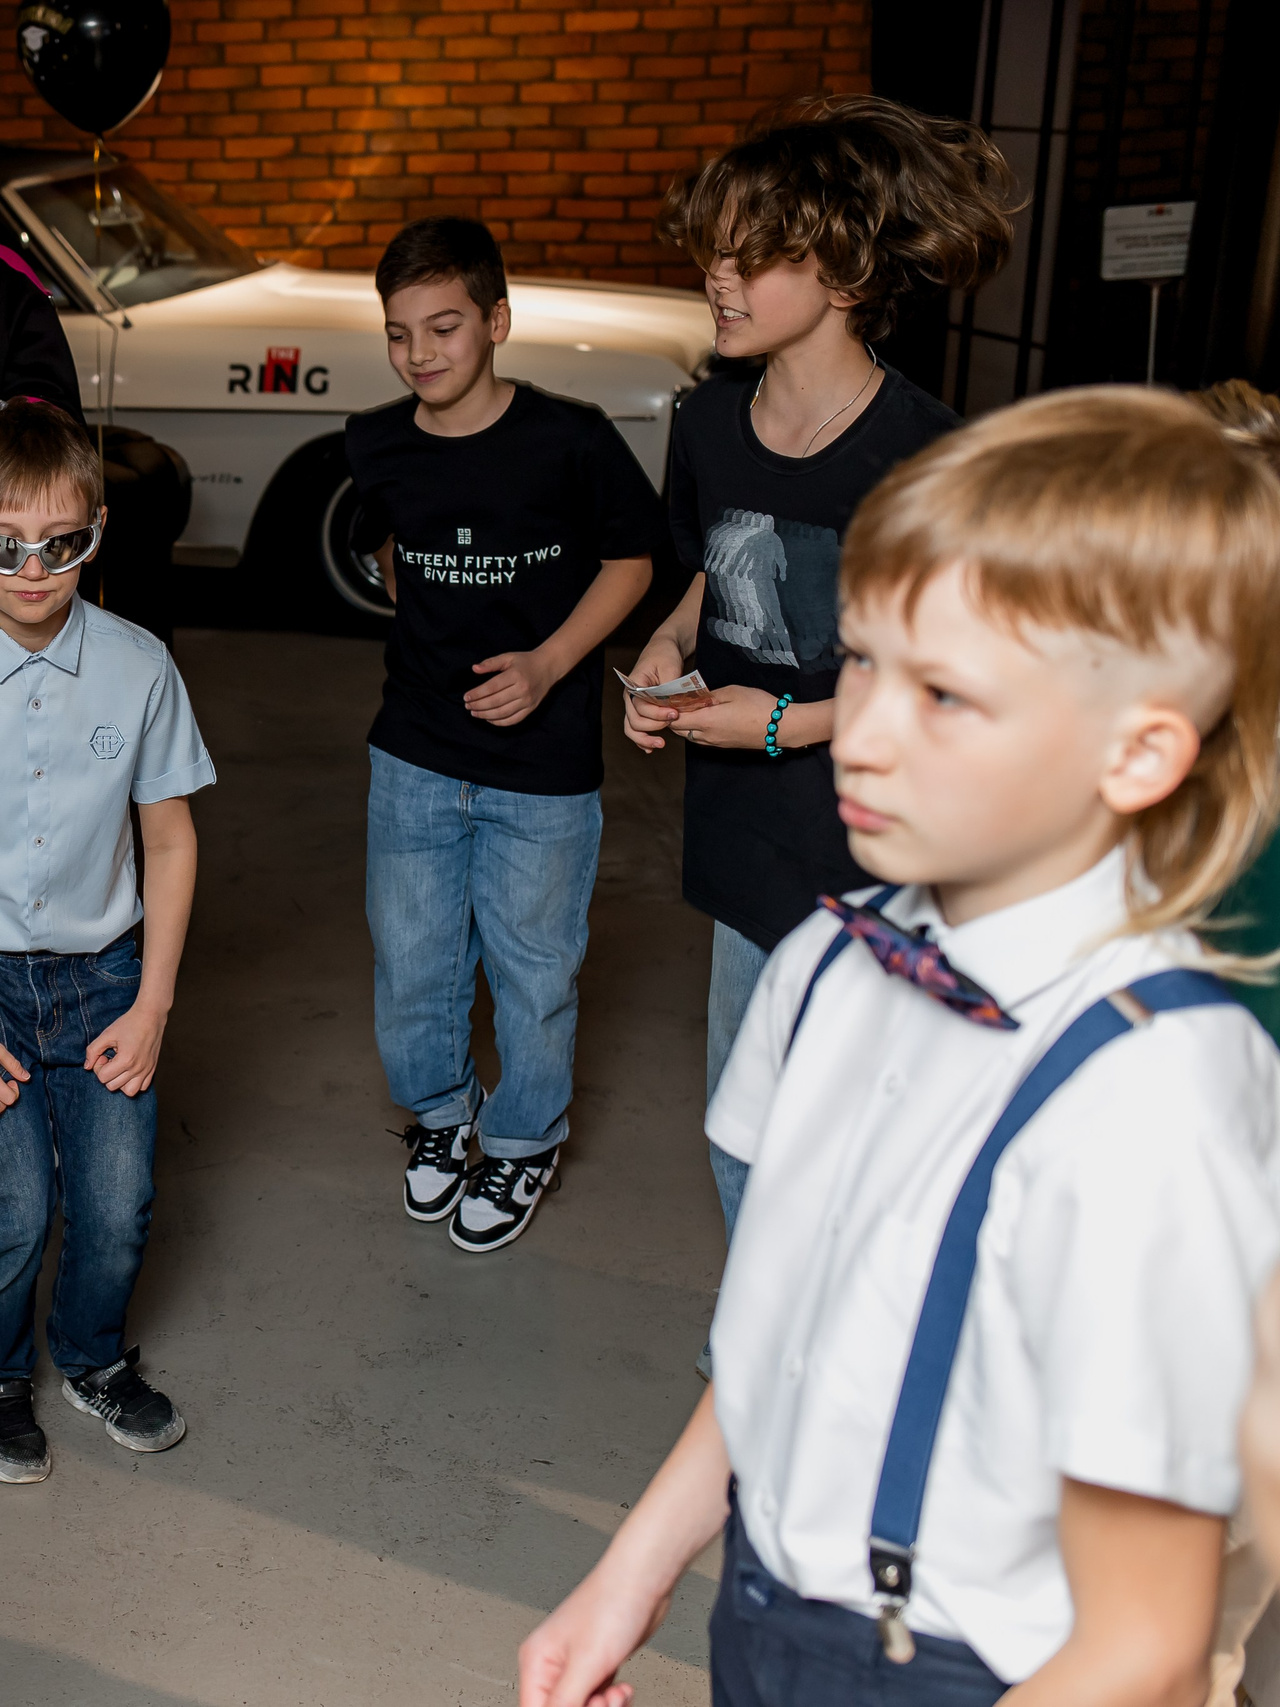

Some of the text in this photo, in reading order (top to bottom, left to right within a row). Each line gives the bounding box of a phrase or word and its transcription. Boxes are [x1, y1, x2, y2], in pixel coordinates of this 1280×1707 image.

[228, 364, 330, 395] RING
[464, 555, 517, 569] FIFTY
[523, 544, 562, 565] TWO
[424, 567, 516, 585] GIVENCHY
